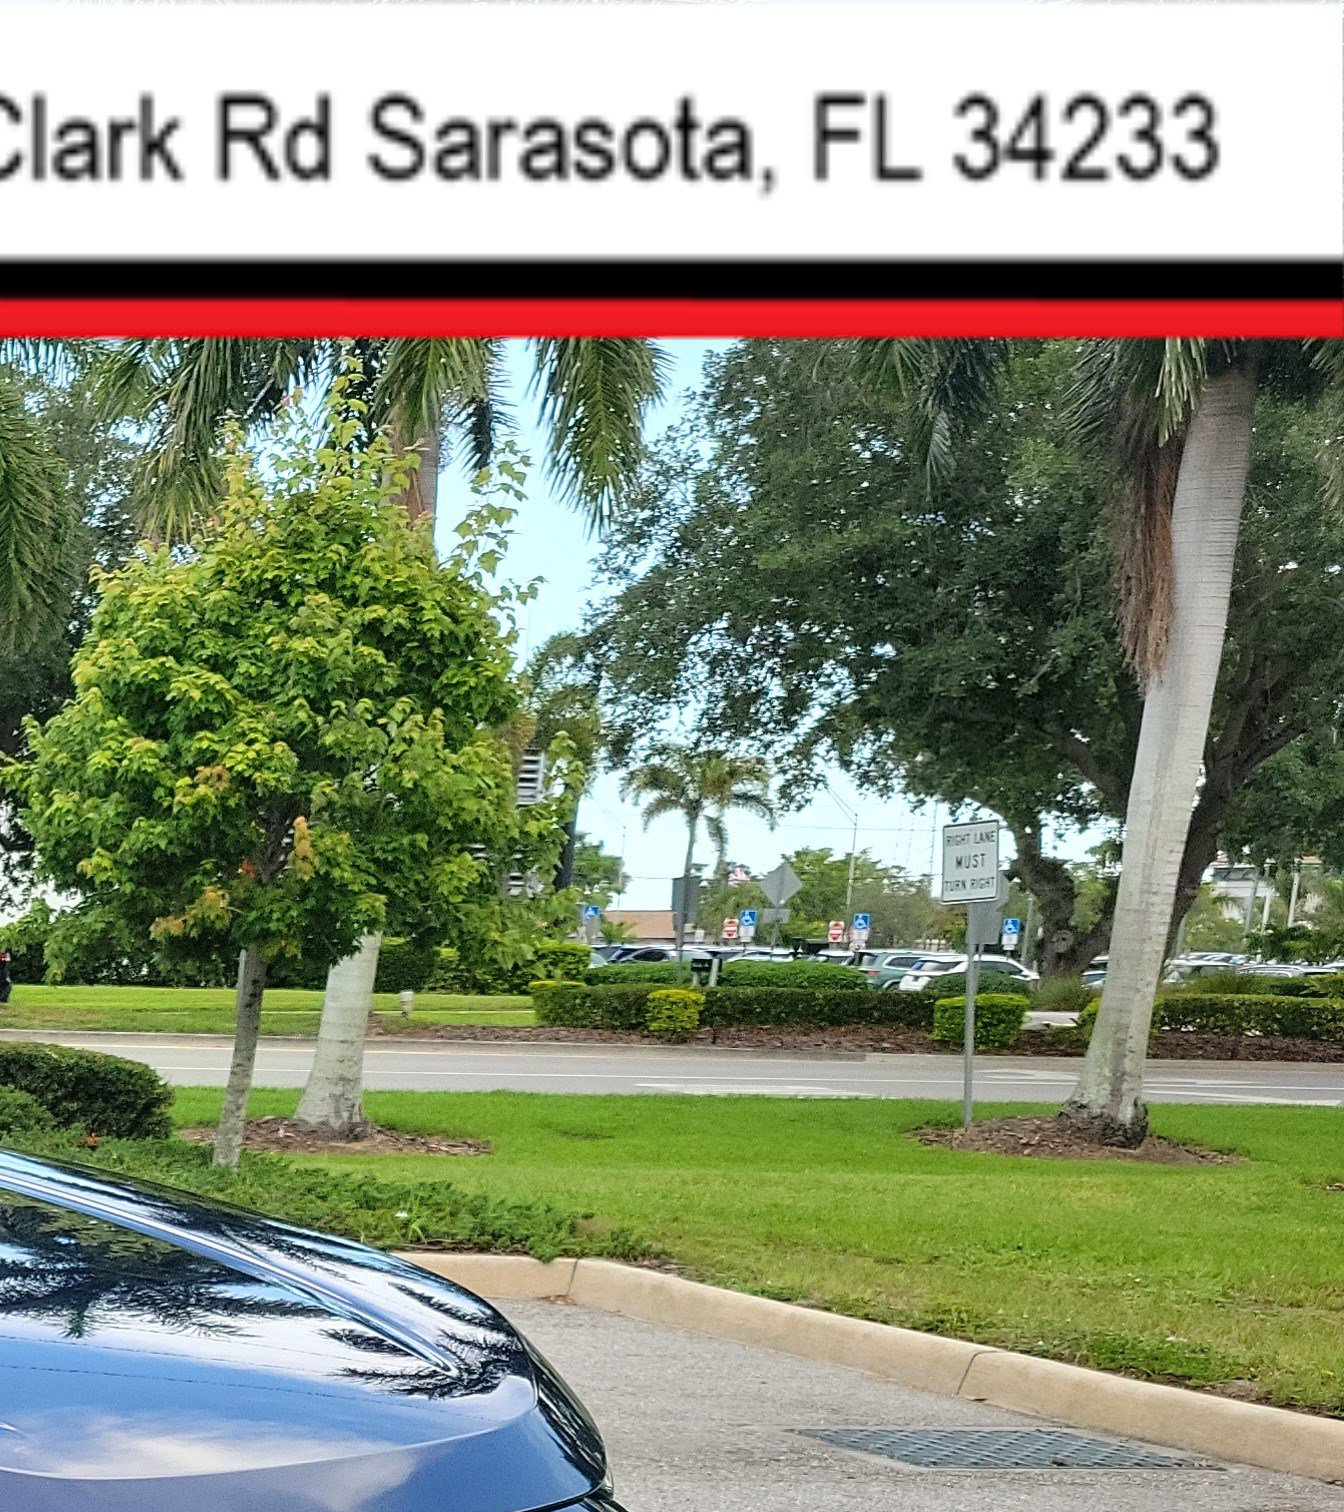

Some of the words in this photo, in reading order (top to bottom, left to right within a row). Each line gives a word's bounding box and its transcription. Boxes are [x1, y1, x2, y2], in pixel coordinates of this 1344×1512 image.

[945, 833, 971, 847] RIGHT
[973, 830, 997, 845] LANE
[955, 852, 986, 870] MUST
[944, 879, 967, 892] TURN
[969, 876, 995, 890] RIGHT
